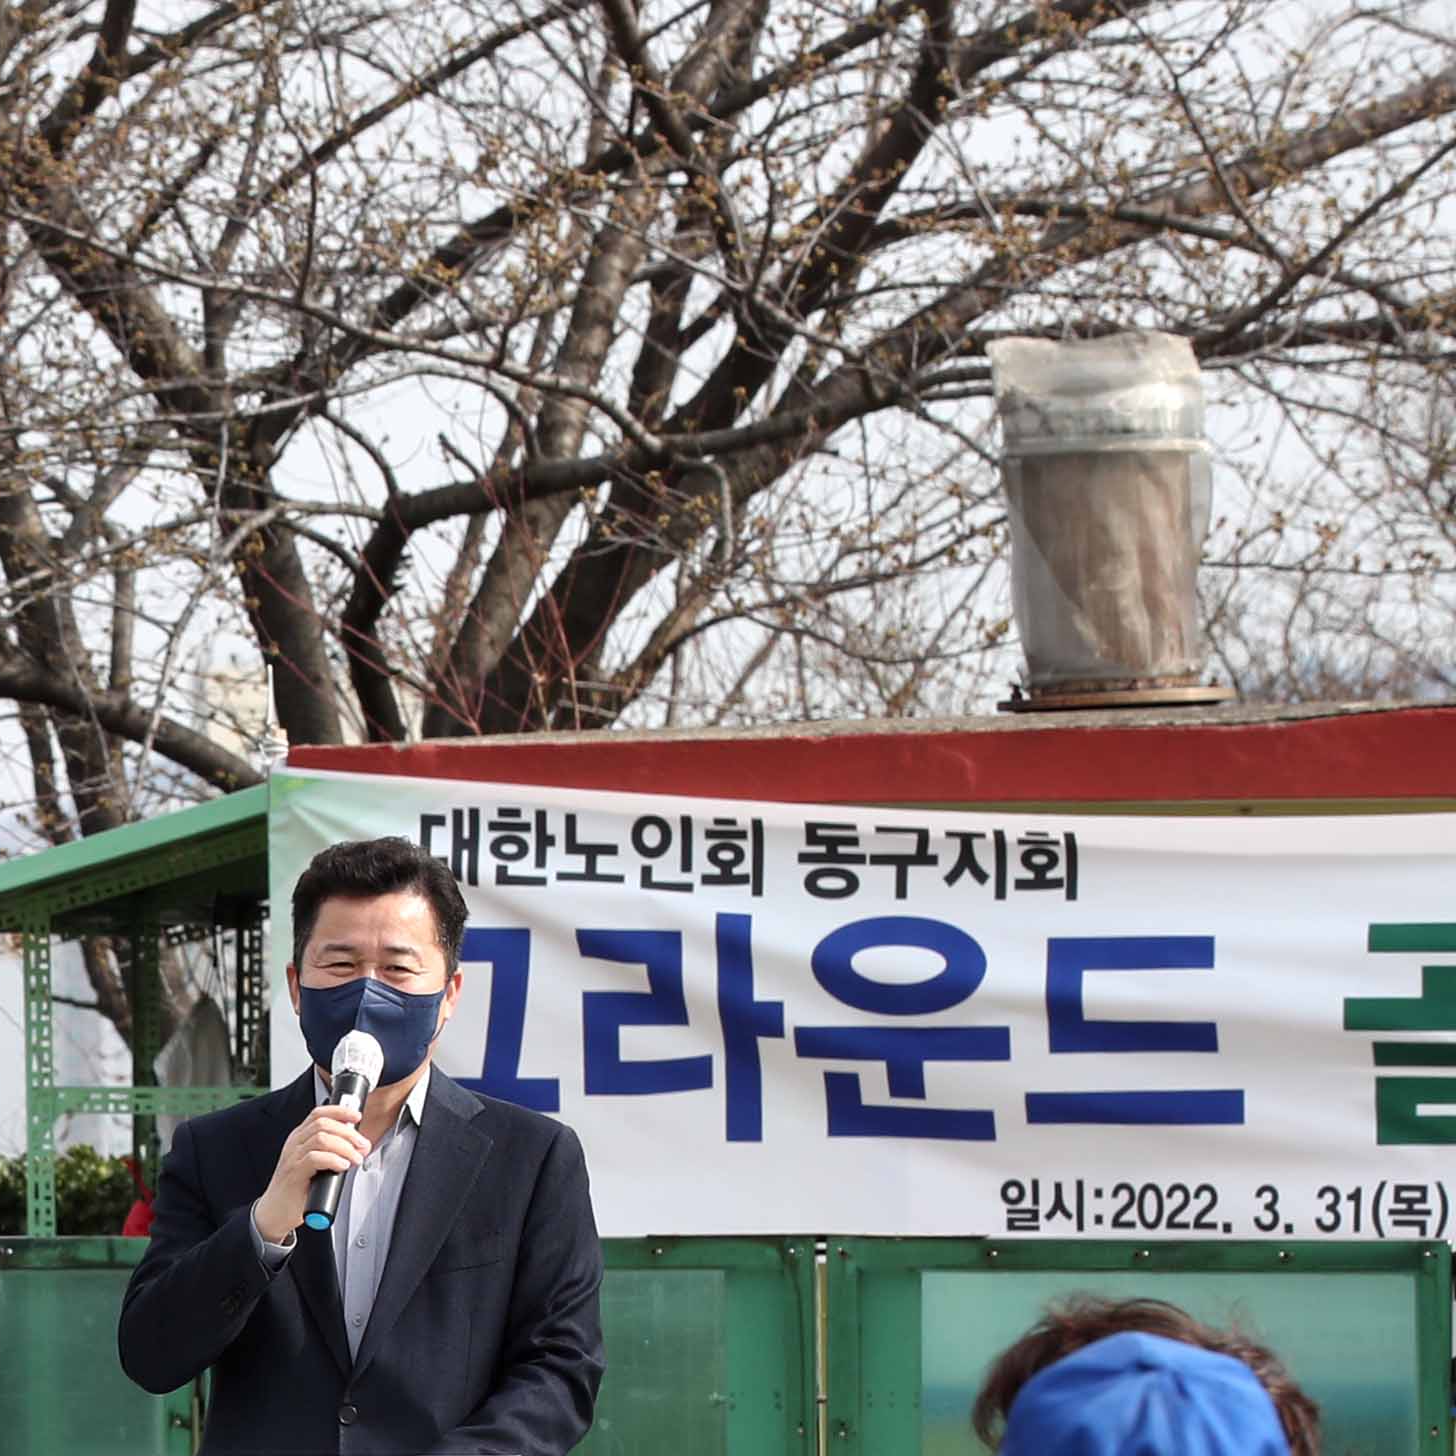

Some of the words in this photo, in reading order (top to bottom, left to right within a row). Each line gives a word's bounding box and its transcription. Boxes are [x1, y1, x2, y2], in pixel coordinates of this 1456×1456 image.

[419, 806, 764, 898] 대한노인회
[797, 821, 1079, 901] 동구지회
[999, 1178, 1233, 1234] 일시:2022.
[1253, 1184, 1295, 1235] 3.
[1314, 1180, 1450, 1239] 31(목)
